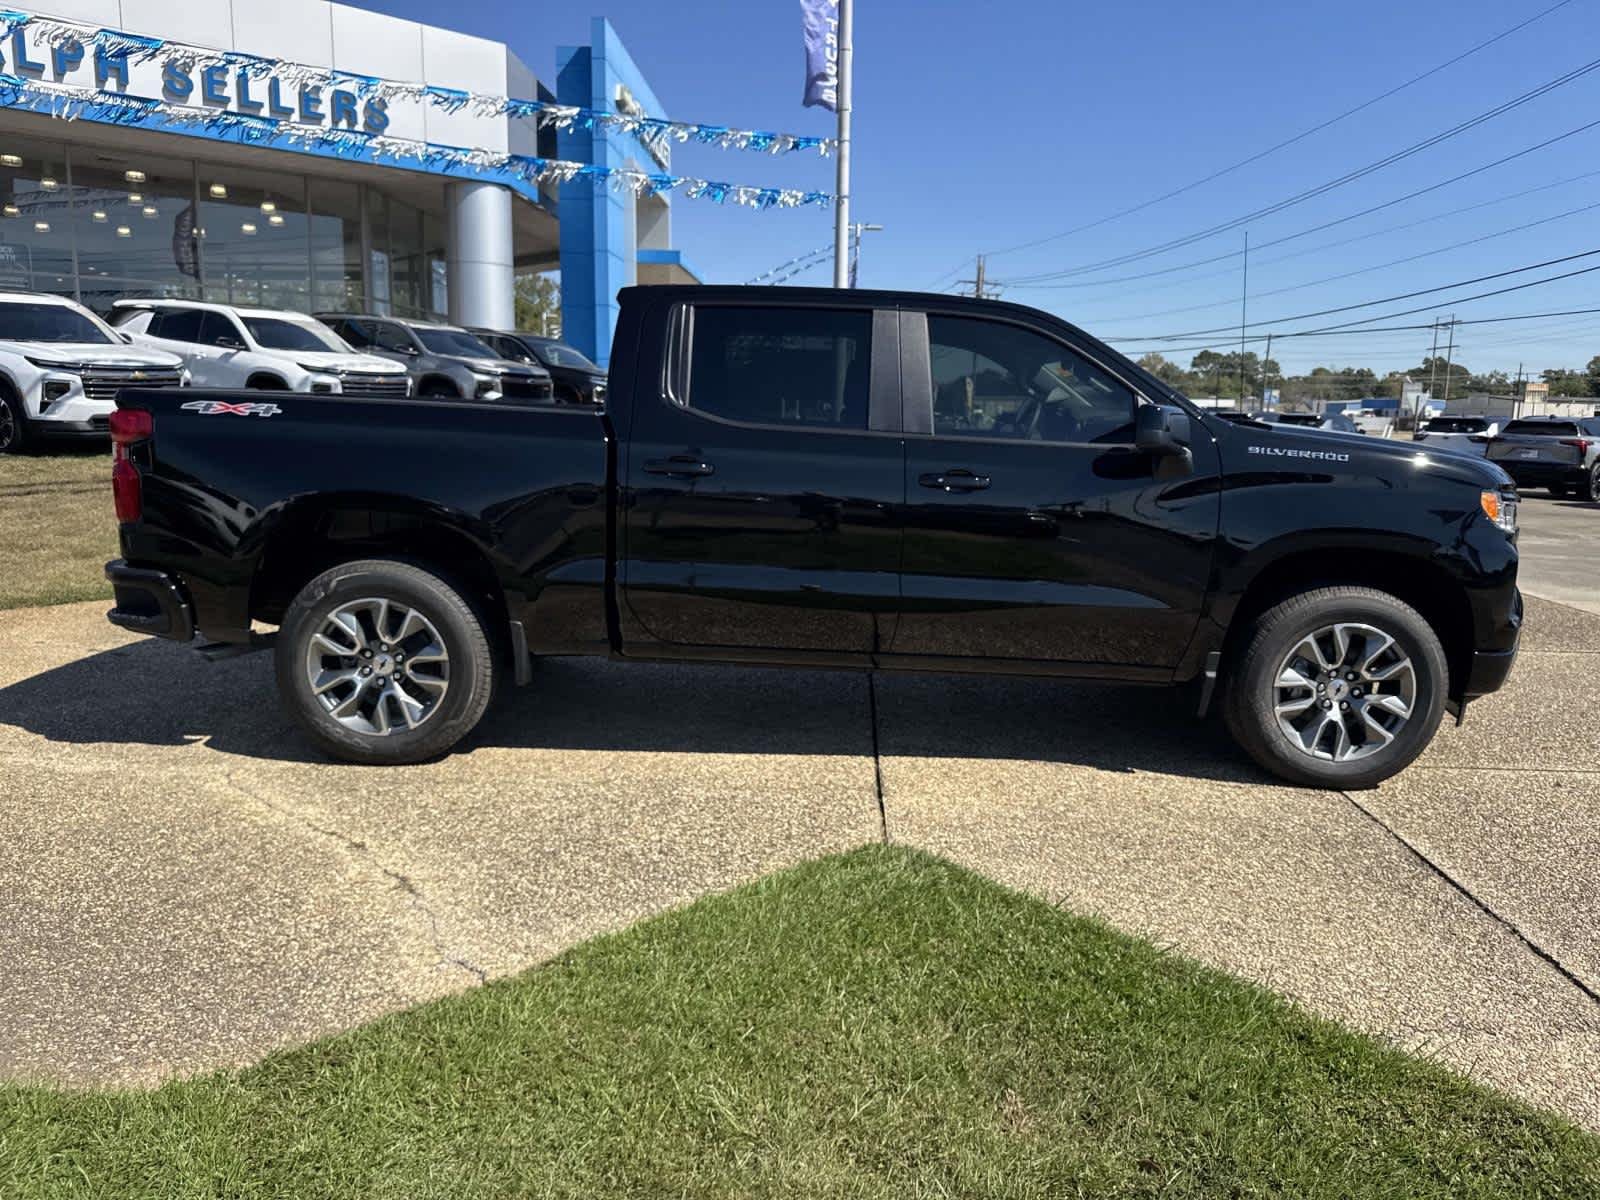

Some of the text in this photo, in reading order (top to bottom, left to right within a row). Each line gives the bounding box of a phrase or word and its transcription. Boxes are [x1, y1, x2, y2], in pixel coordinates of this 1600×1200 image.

[0, 27, 389, 131] LPH SELLERS
[1247, 446, 1350, 462] SILVERADO
